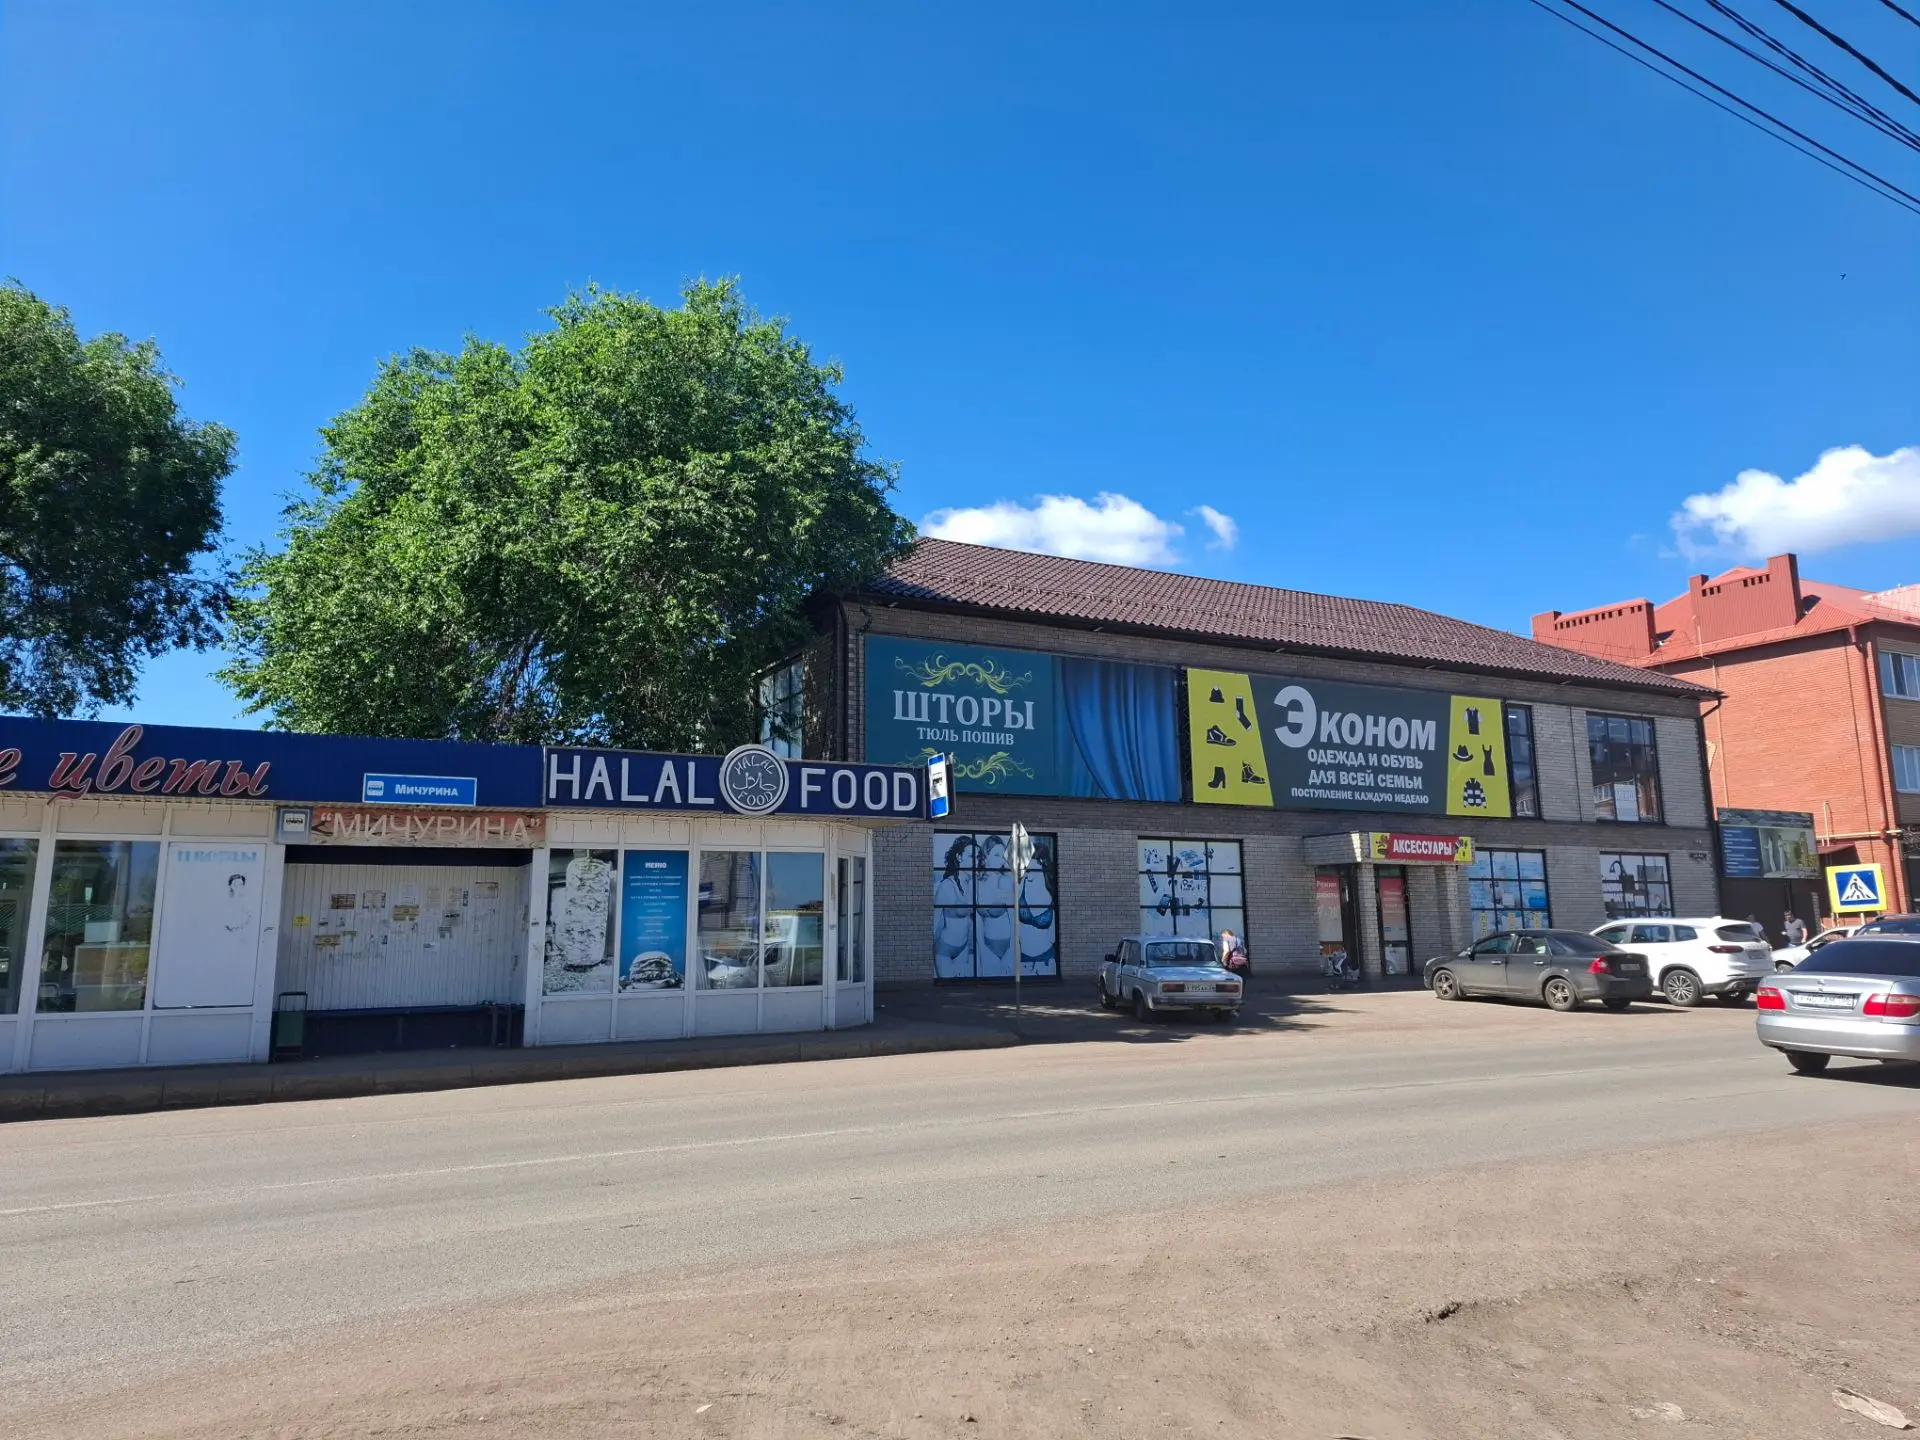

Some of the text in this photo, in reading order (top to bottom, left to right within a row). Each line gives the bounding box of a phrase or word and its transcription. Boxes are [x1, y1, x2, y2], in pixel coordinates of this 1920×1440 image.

[893, 690, 1035, 730] ШТОРЫ
[916, 727, 1014, 745] ТЮЛЬ ПОШИВ
[48, 724, 270, 805] цветы
[733, 755, 775, 775] HALAL
[1308, 748, 1423, 770] ОДЕЖДА И ОБУВЬ
[549, 754, 917, 812] HALAL FOOD
[1309, 770, 1422, 789] ДЛЯ ВСЕЙ СЕМЬИ
[737, 791, 773, 806] FOOD
[1291, 787, 1429, 805] ПОСТУПЛЕНИЕ КАЖДУЮ НЕДЕЛЮ
[1393, 839, 1452, 856] АКСЕССУАРЫ
